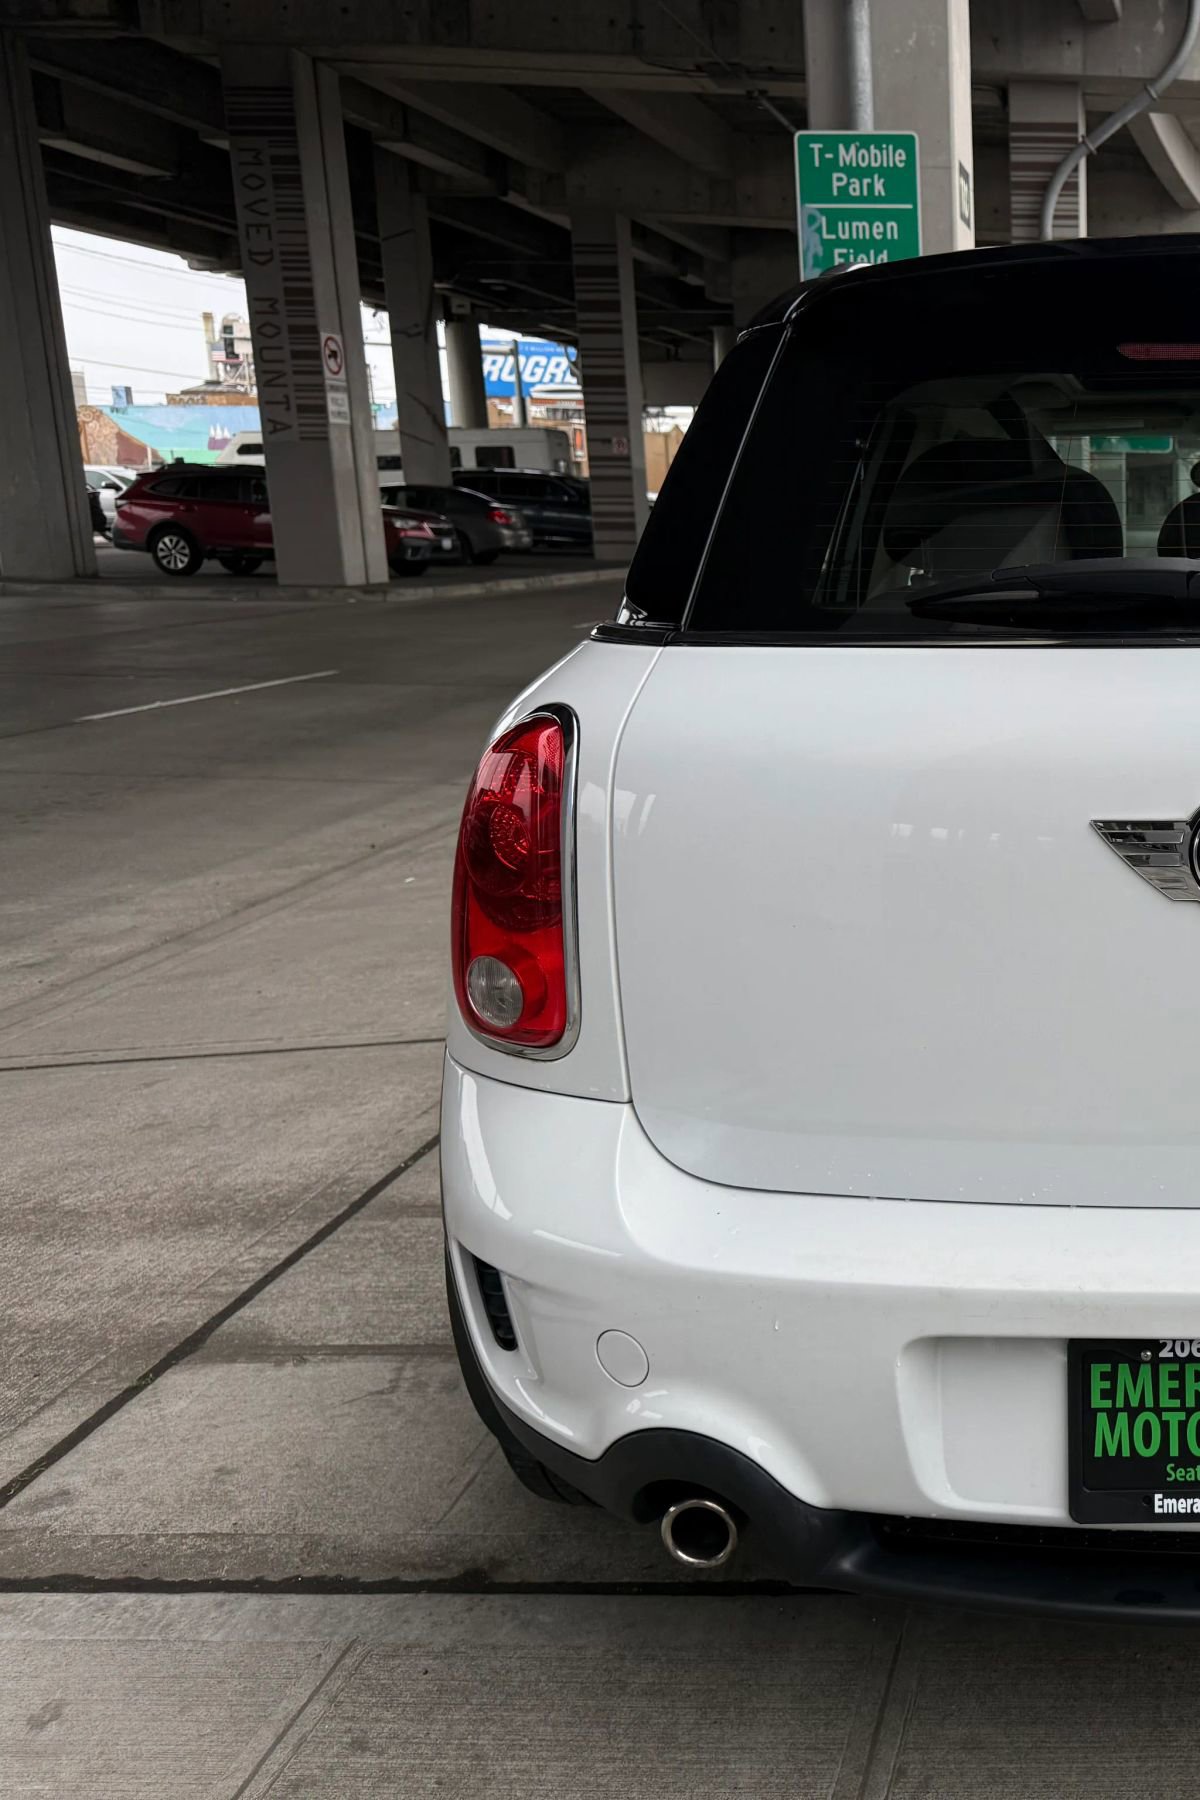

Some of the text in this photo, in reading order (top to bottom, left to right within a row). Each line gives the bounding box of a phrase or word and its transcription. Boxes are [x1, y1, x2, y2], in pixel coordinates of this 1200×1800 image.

[809, 143, 907, 168] T-Mobile
[832, 173, 886, 197] Park
[821, 215, 899, 240] Lumen
[238, 147, 292, 435] MOVED MOUNTA
